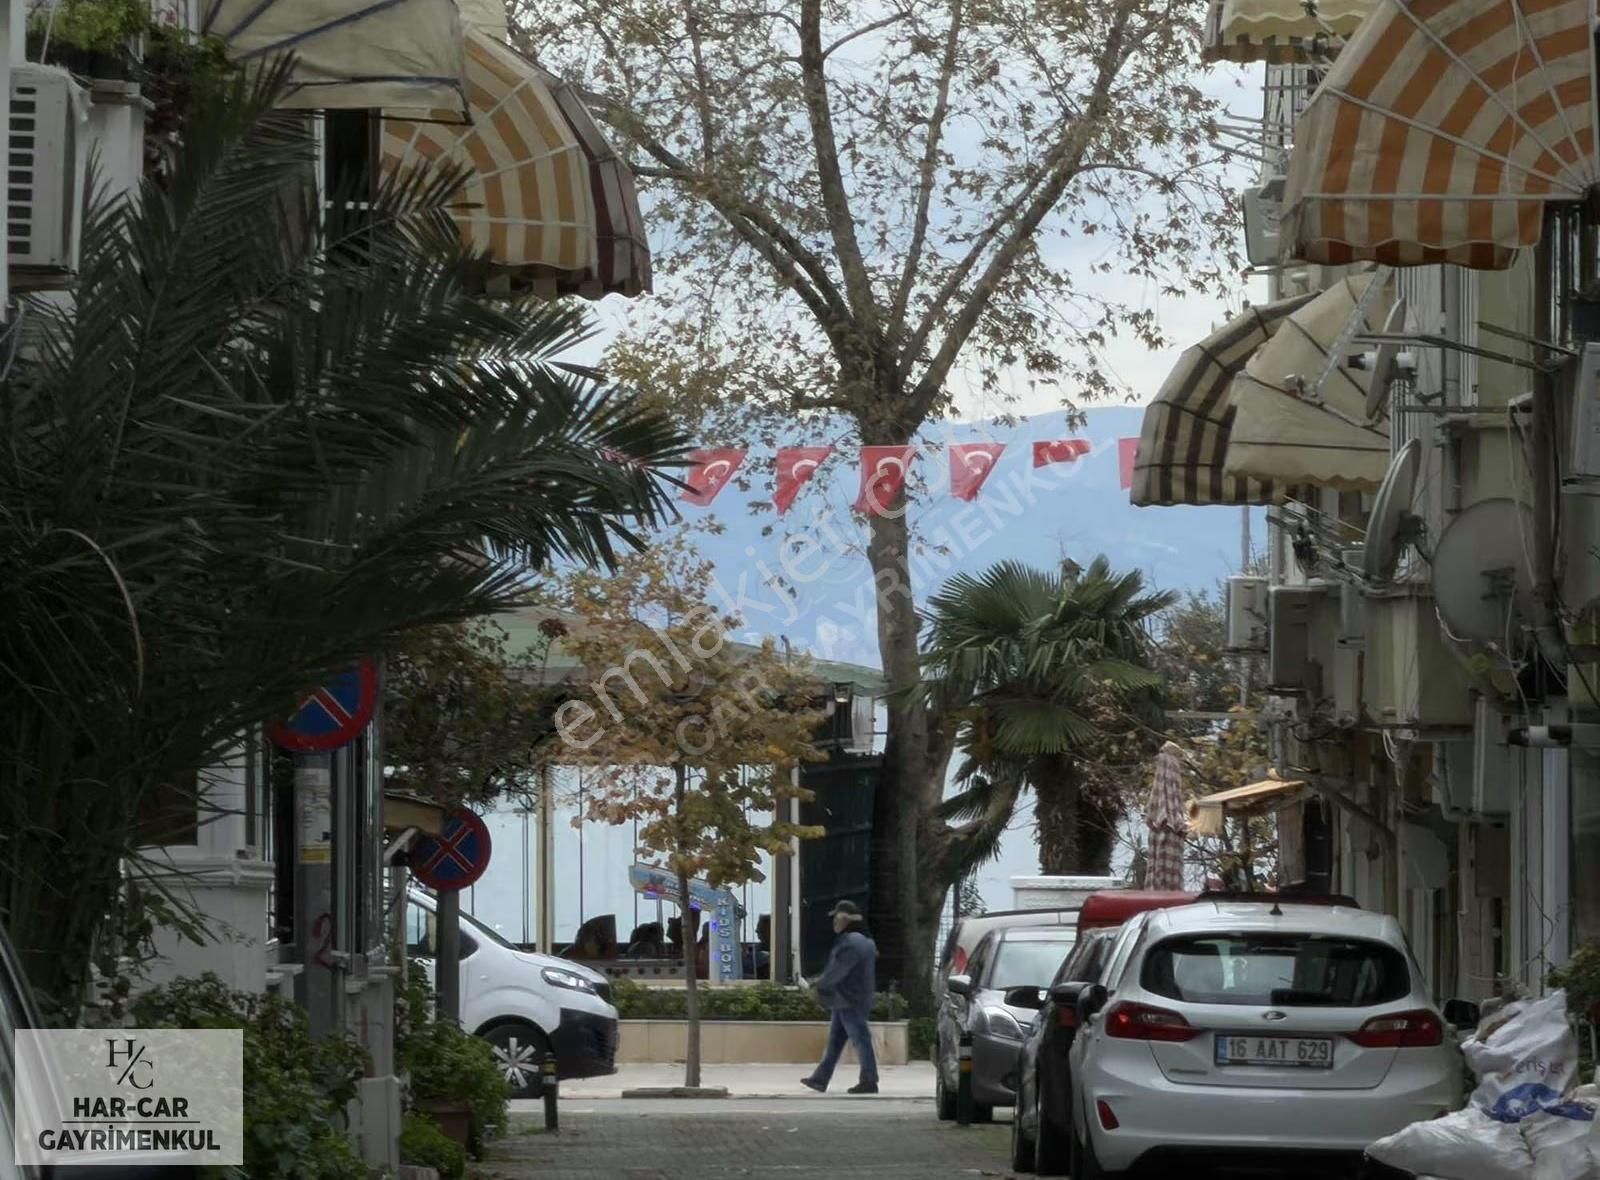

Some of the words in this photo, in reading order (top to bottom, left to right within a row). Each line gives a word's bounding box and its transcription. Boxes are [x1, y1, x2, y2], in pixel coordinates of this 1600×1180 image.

[1230, 1039, 1247, 1058] 16
[1256, 1040, 1289, 1059] AAT
[1297, 1041, 1329, 1061] 629
